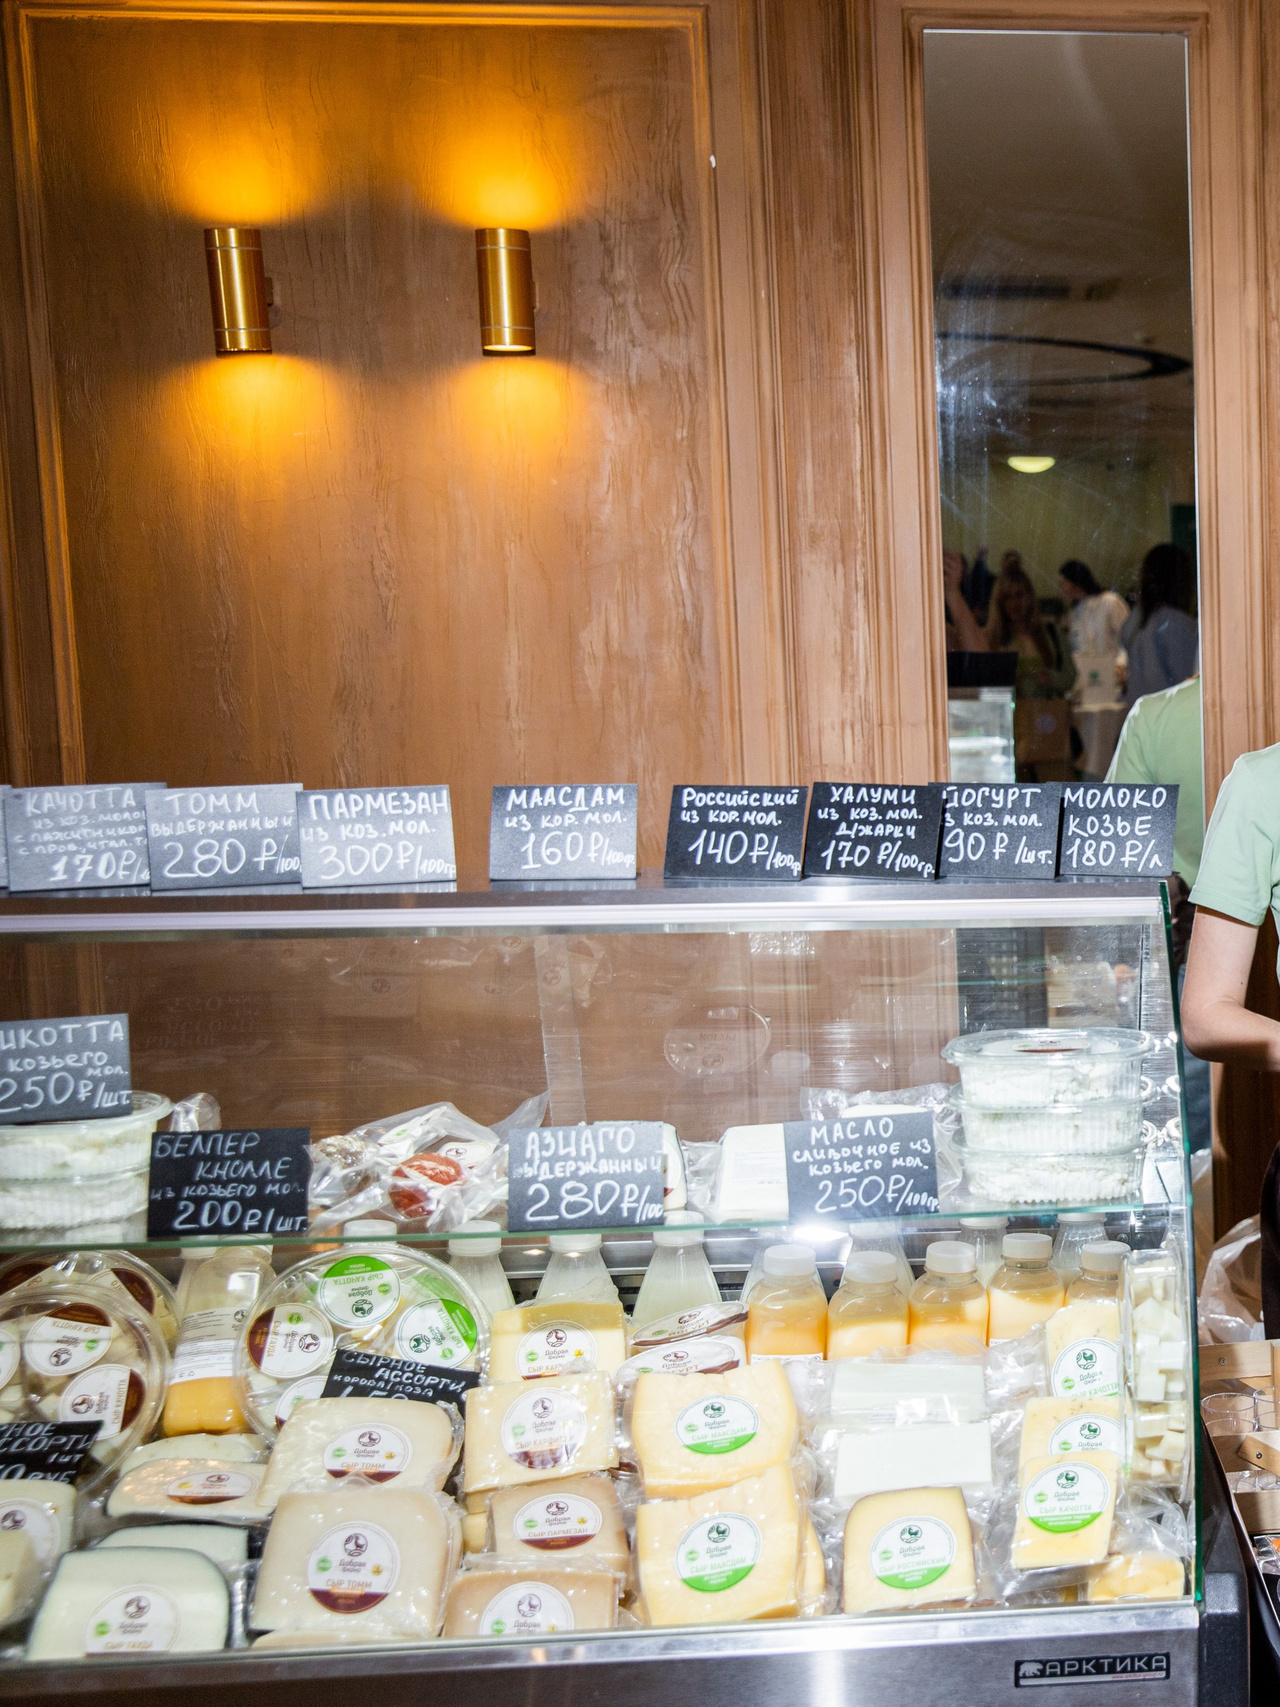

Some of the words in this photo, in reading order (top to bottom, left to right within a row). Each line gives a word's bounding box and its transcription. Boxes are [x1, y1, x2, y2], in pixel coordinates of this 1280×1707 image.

[25, 787, 136, 816] КАЧОТТА
[164, 791, 260, 816] ТОММ
[505, 786, 625, 812] МААСДАМ
[830, 785, 916, 805] ХАЛУМИ
[942, 786, 1041, 809] ЙОГУРТ
[1064, 786, 1167, 809] МОЛОКО
[309, 790, 448, 820] ПАРМЕЗАН
[944, 812, 955, 827] з
[1068, 814, 1152, 838] КОЗЬЕ
[944, 828, 986, 863] 90
[0, 1020, 124, 1050] ИКОТТА
[810, 1117, 893, 1146] МАСЛО
[155, 1132, 260, 1158] БЕЛПЕР
[194, 1157, 292, 1181] КНОЛЛЕ
[334, 1275, 365, 1285] КАЧОТТА
[368, 1273, 384, 1281] СЫР
[51, 1320, 83, 1331] КАЧОТТА
[83, 1325, 100, 1334] СЫР
[272, 1320, 282, 1336] СЫР
[437, 1308, 455, 1334] КАЧОТТА
[266, 1337, 277, 1357] ГАУДА
[452, 1336, 464, 1348] СЫР
[545, 1348, 569, 1356] Добрая
[342, 1351, 430, 1373] СЫРНОЕ
[374, 1367, 467, 1392] АССОРТИ
[115, 1379, 127, 1408] КАЧОТТА
[112, 1410, 121, 1424] СЫР
[711, 1427, 747, 1438] МААСДАМ
[0, 1434, 98, 1452] ССОРТИ
[1060, 1504, 1092, 1513] КАЧОТТА
[548, 1528, 588, 1536] ПАРМЕЗАН
[706, 1545, 732, 1554] Добрая
[899, 1545, 925, 1553] Добрая
[339, 1559, 367, 1568] Добрая
[690, 1564, 708, 1573] СЫР
[711, 1557, 747, 1570] МААСДАМ
[879, 1564, 896, 1573] СЫР
[897, 1556, 947, 1569] РОССИЙСКИЙ
[326, 1579, 345, 1587] СЫР
[347, 1580, 373, 1588] ТОММ
[513, 1620, 541, 1628] Добрая
[1045, 1655, 1167, 1676] АРКТИКА
